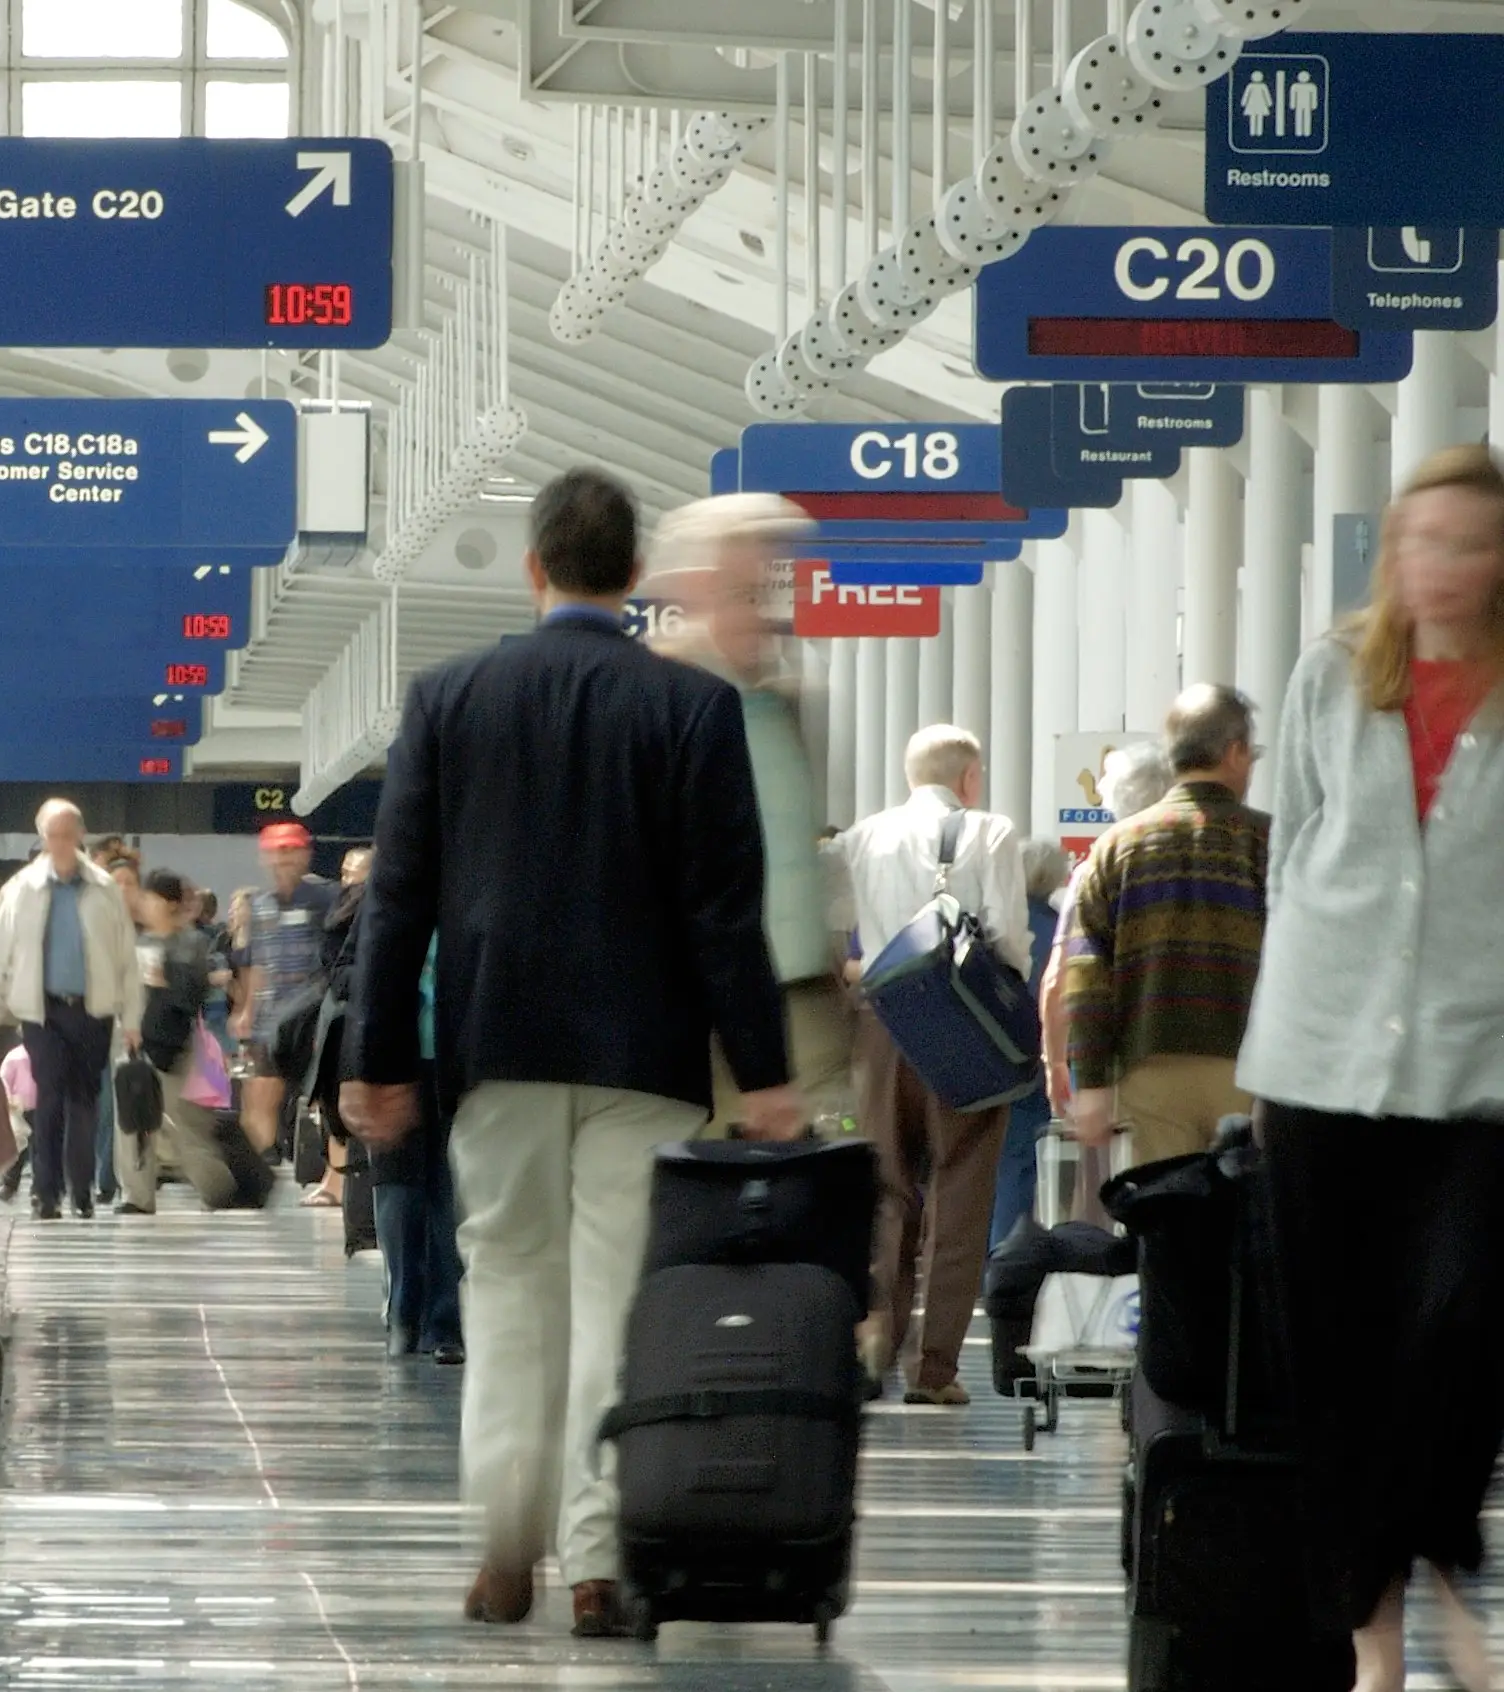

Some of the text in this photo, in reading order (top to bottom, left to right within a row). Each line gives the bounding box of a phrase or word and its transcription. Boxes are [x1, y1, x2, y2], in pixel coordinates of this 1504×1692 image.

[1228, 169, 1330, 188] Restrooms
[92, 190, 164, 220] C20
[1114, 237, 1275, 301] C20
[268, 286, 351, 325] 10:59
[1366, 293, 1463, 310] Telephones
[1137, 416, 1213, 429] Restrooms
[24, 433, 138, 460] C18,C18a
[850, 431, 959, 480] C18
[1080, 450, 1152, 462] Restaurant
[58, 462, 138, 481] Service
[49, 484, 123, 503] Center
[184, 615, 229, 638] 10:59
[621, 604, 686, 637] C16
[254, 788, 284, 810] C2
[1062, 810, 1112, 823] FOOD
